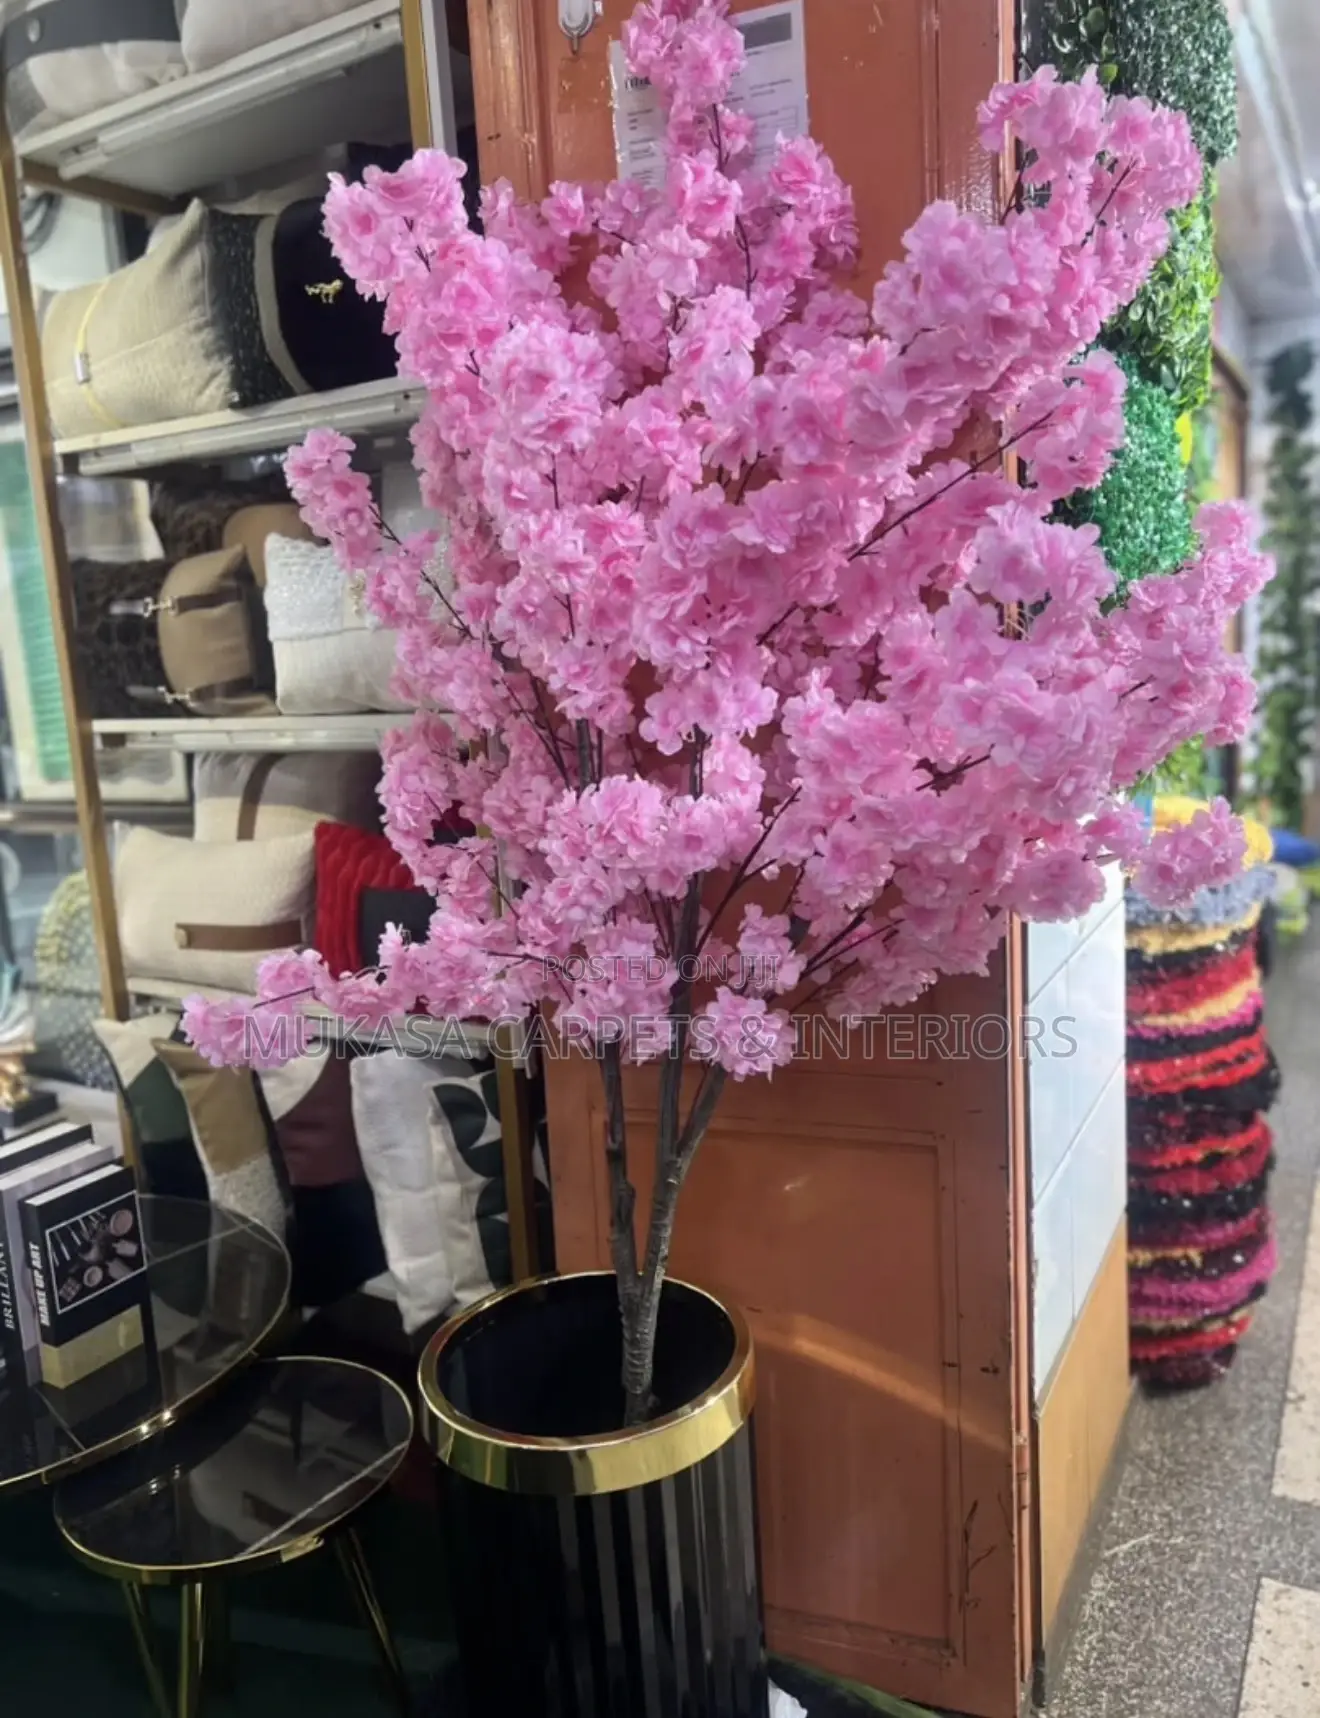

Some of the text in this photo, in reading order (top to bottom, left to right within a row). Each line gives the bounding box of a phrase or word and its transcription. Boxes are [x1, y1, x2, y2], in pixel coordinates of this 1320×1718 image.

[29, 1242, 50, 1327] MAKE UP ART
